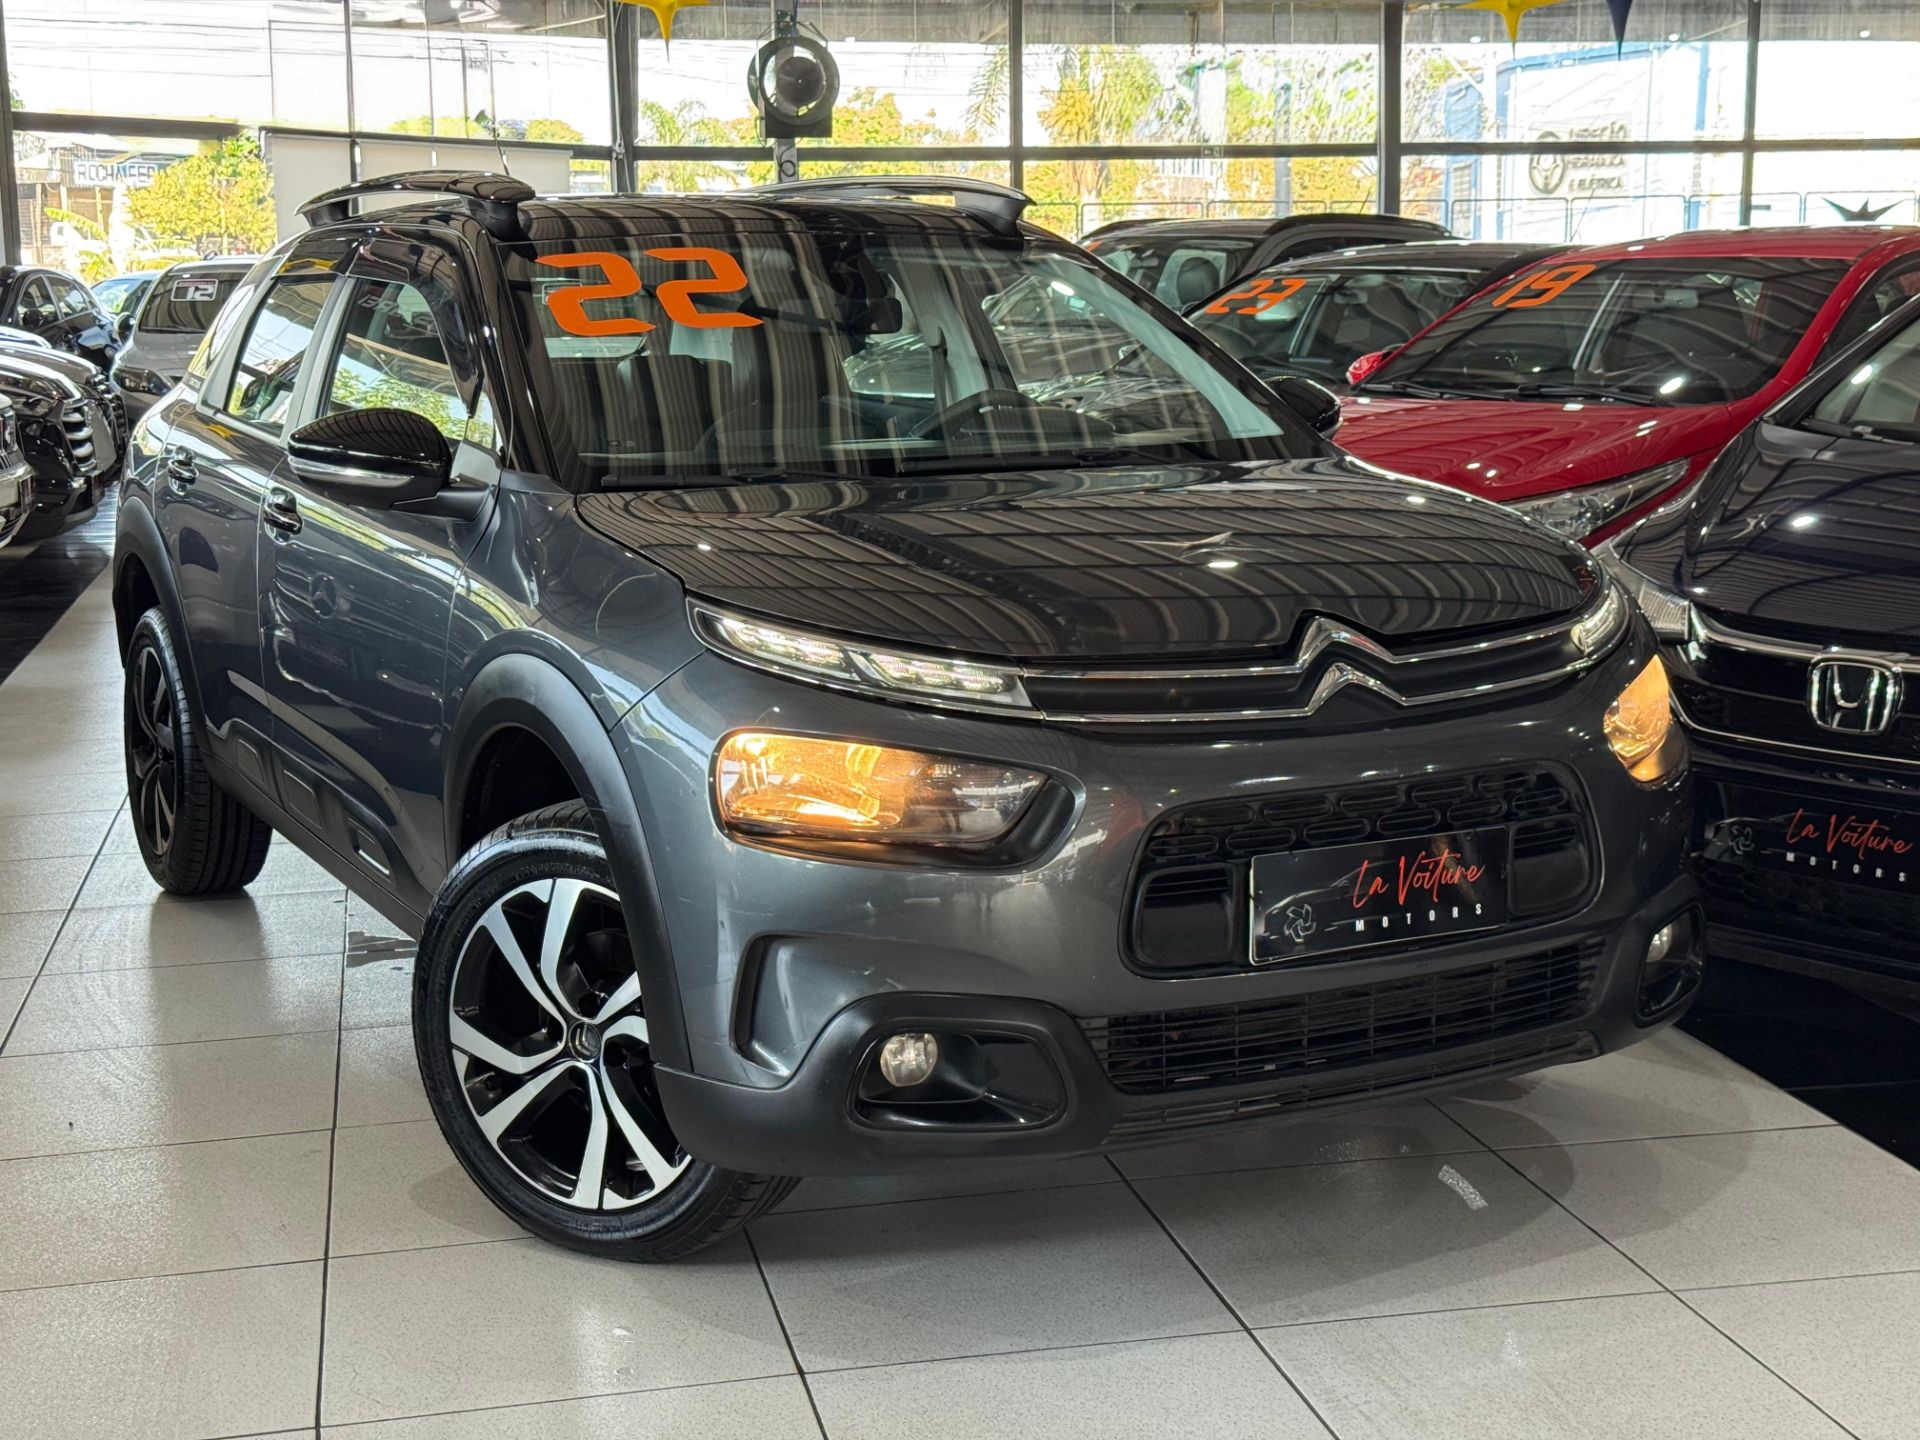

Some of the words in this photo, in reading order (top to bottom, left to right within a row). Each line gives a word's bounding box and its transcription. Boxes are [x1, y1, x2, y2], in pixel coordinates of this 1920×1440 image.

[534, 247, 765, 336] 22
[1204, 278, 1307, 316] 23
[1492, 264, 1597, 309] 19
[1785, 808, 1820, 844] La
[1826, 814, 1914, 860] Voiture
[1353, 859, 1390, 909] La
[1398, 848, 1487, 906] Voiture
[1786, 851, 1907, 882] MOTORS
[1355, 903, 1483, 932] MOTORS
